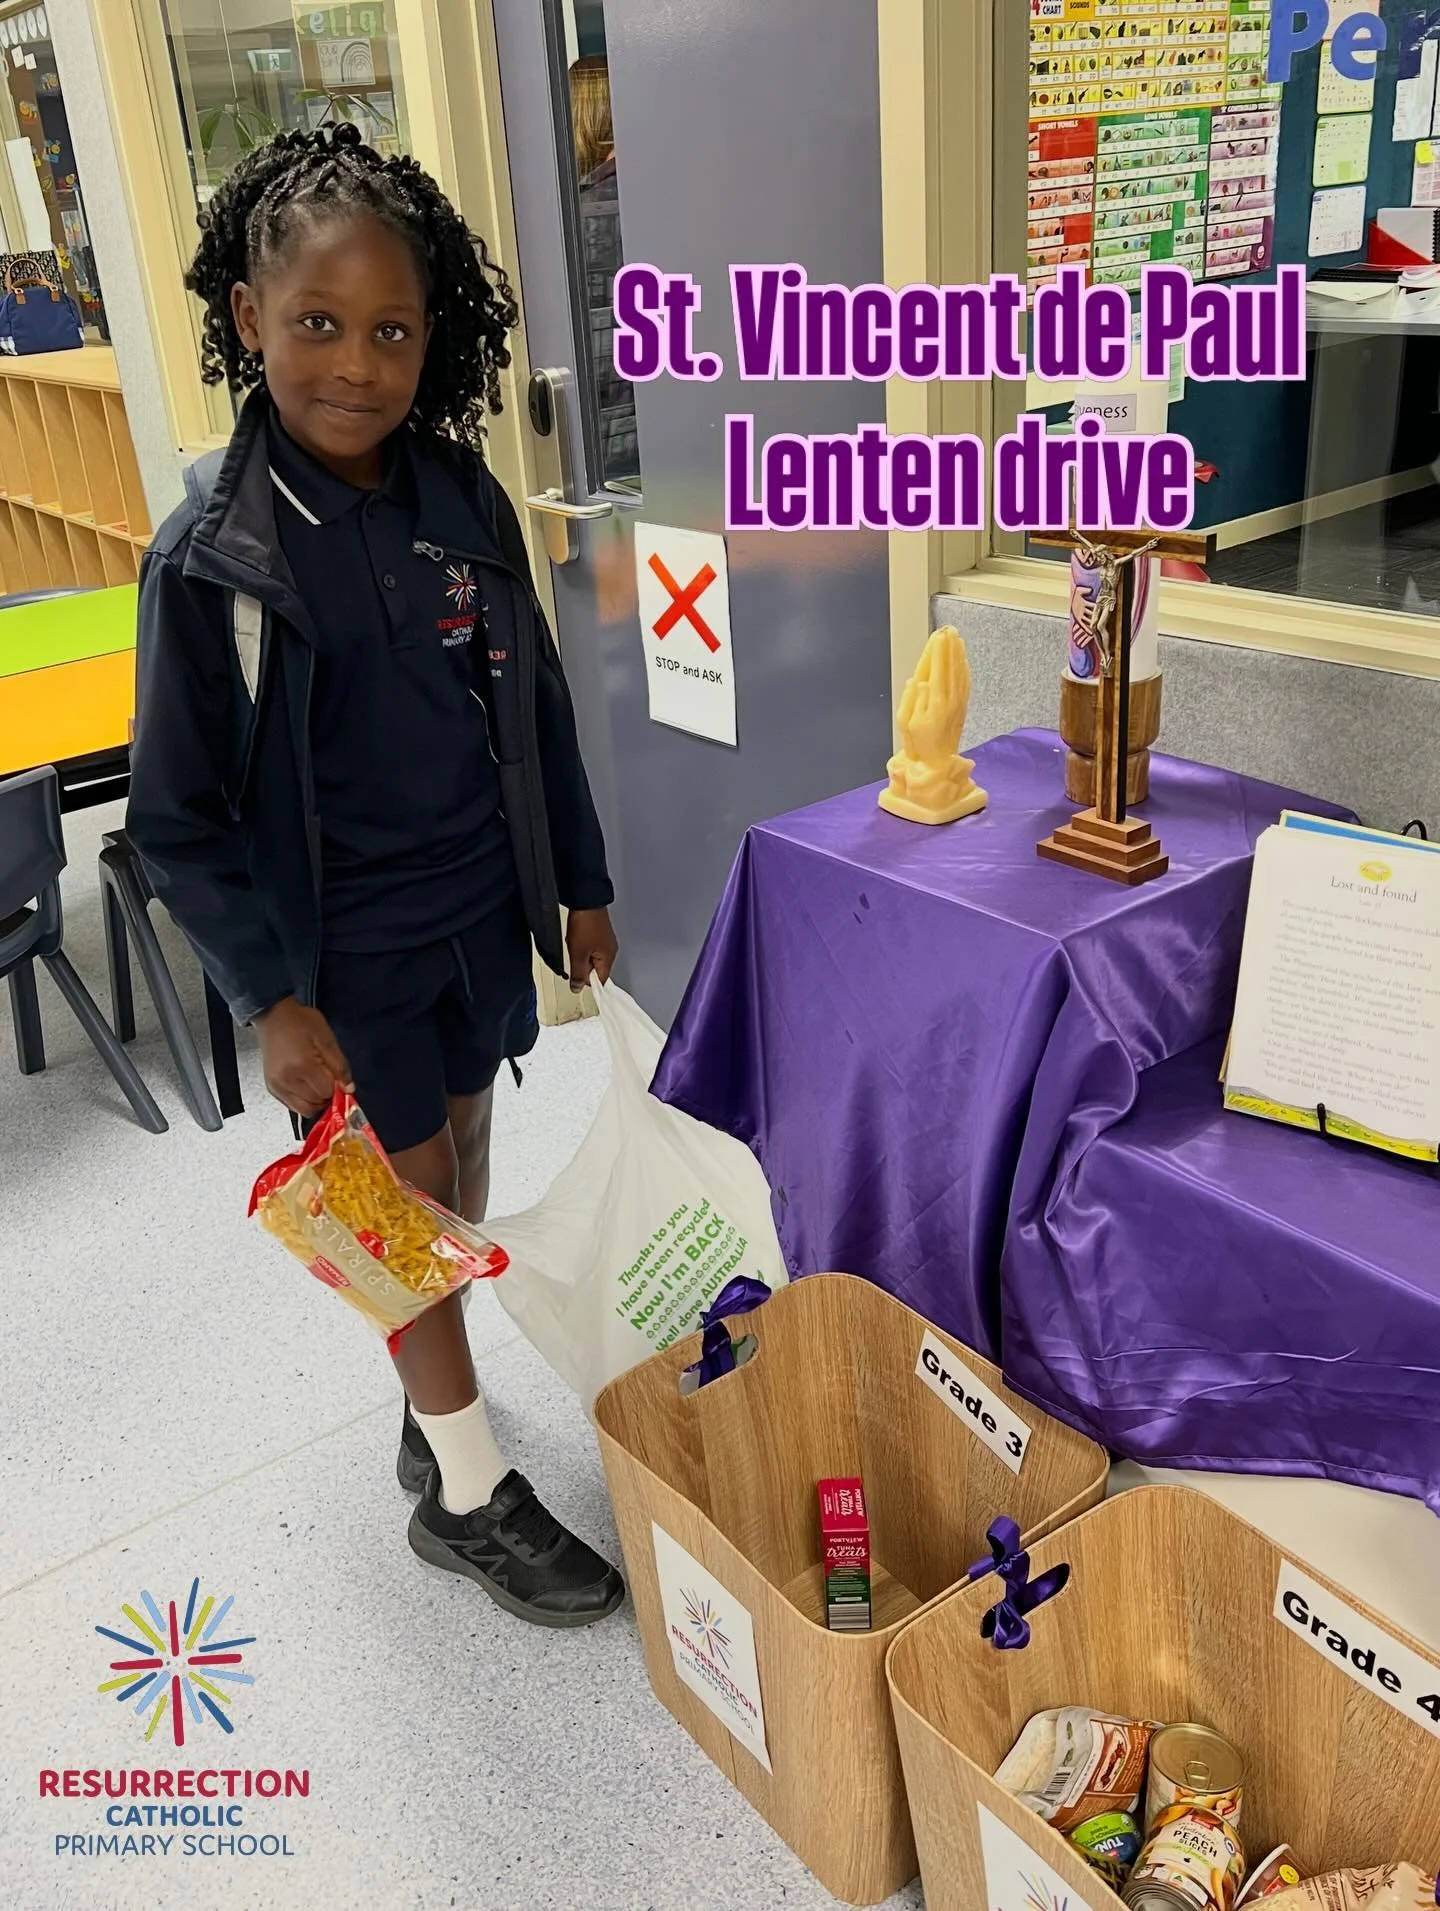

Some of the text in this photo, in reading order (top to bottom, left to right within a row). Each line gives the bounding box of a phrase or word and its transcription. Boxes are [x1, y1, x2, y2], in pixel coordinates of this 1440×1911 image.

[655, 656, 723, 685] STOP and ASK
[1331, 875, 1417, 903] Lost and found
[313, 1217, 396, 1296] SPIRALS
[615, 1198, 711, 1318] I have been recycled
[618, 1203, 689, 1286] Thanks to you
[630, 1212, 725, 1331] Now I'm BACK
[679, 1300, 704, 1328] done
[700, 1236, 748, 1300] AUSTRALIA
[922, 1348, 1023, 1458] Grade 3
[826, 1545, 868, 1558] treats
[672, 1624, 758, 1719] RESURRECTION
[694, 1657, 739, 1706] CATHOLIC
[1283, 1590, 1440, 1723] Grade 4
[1173, 1830, 1218, 1857] PEACH
